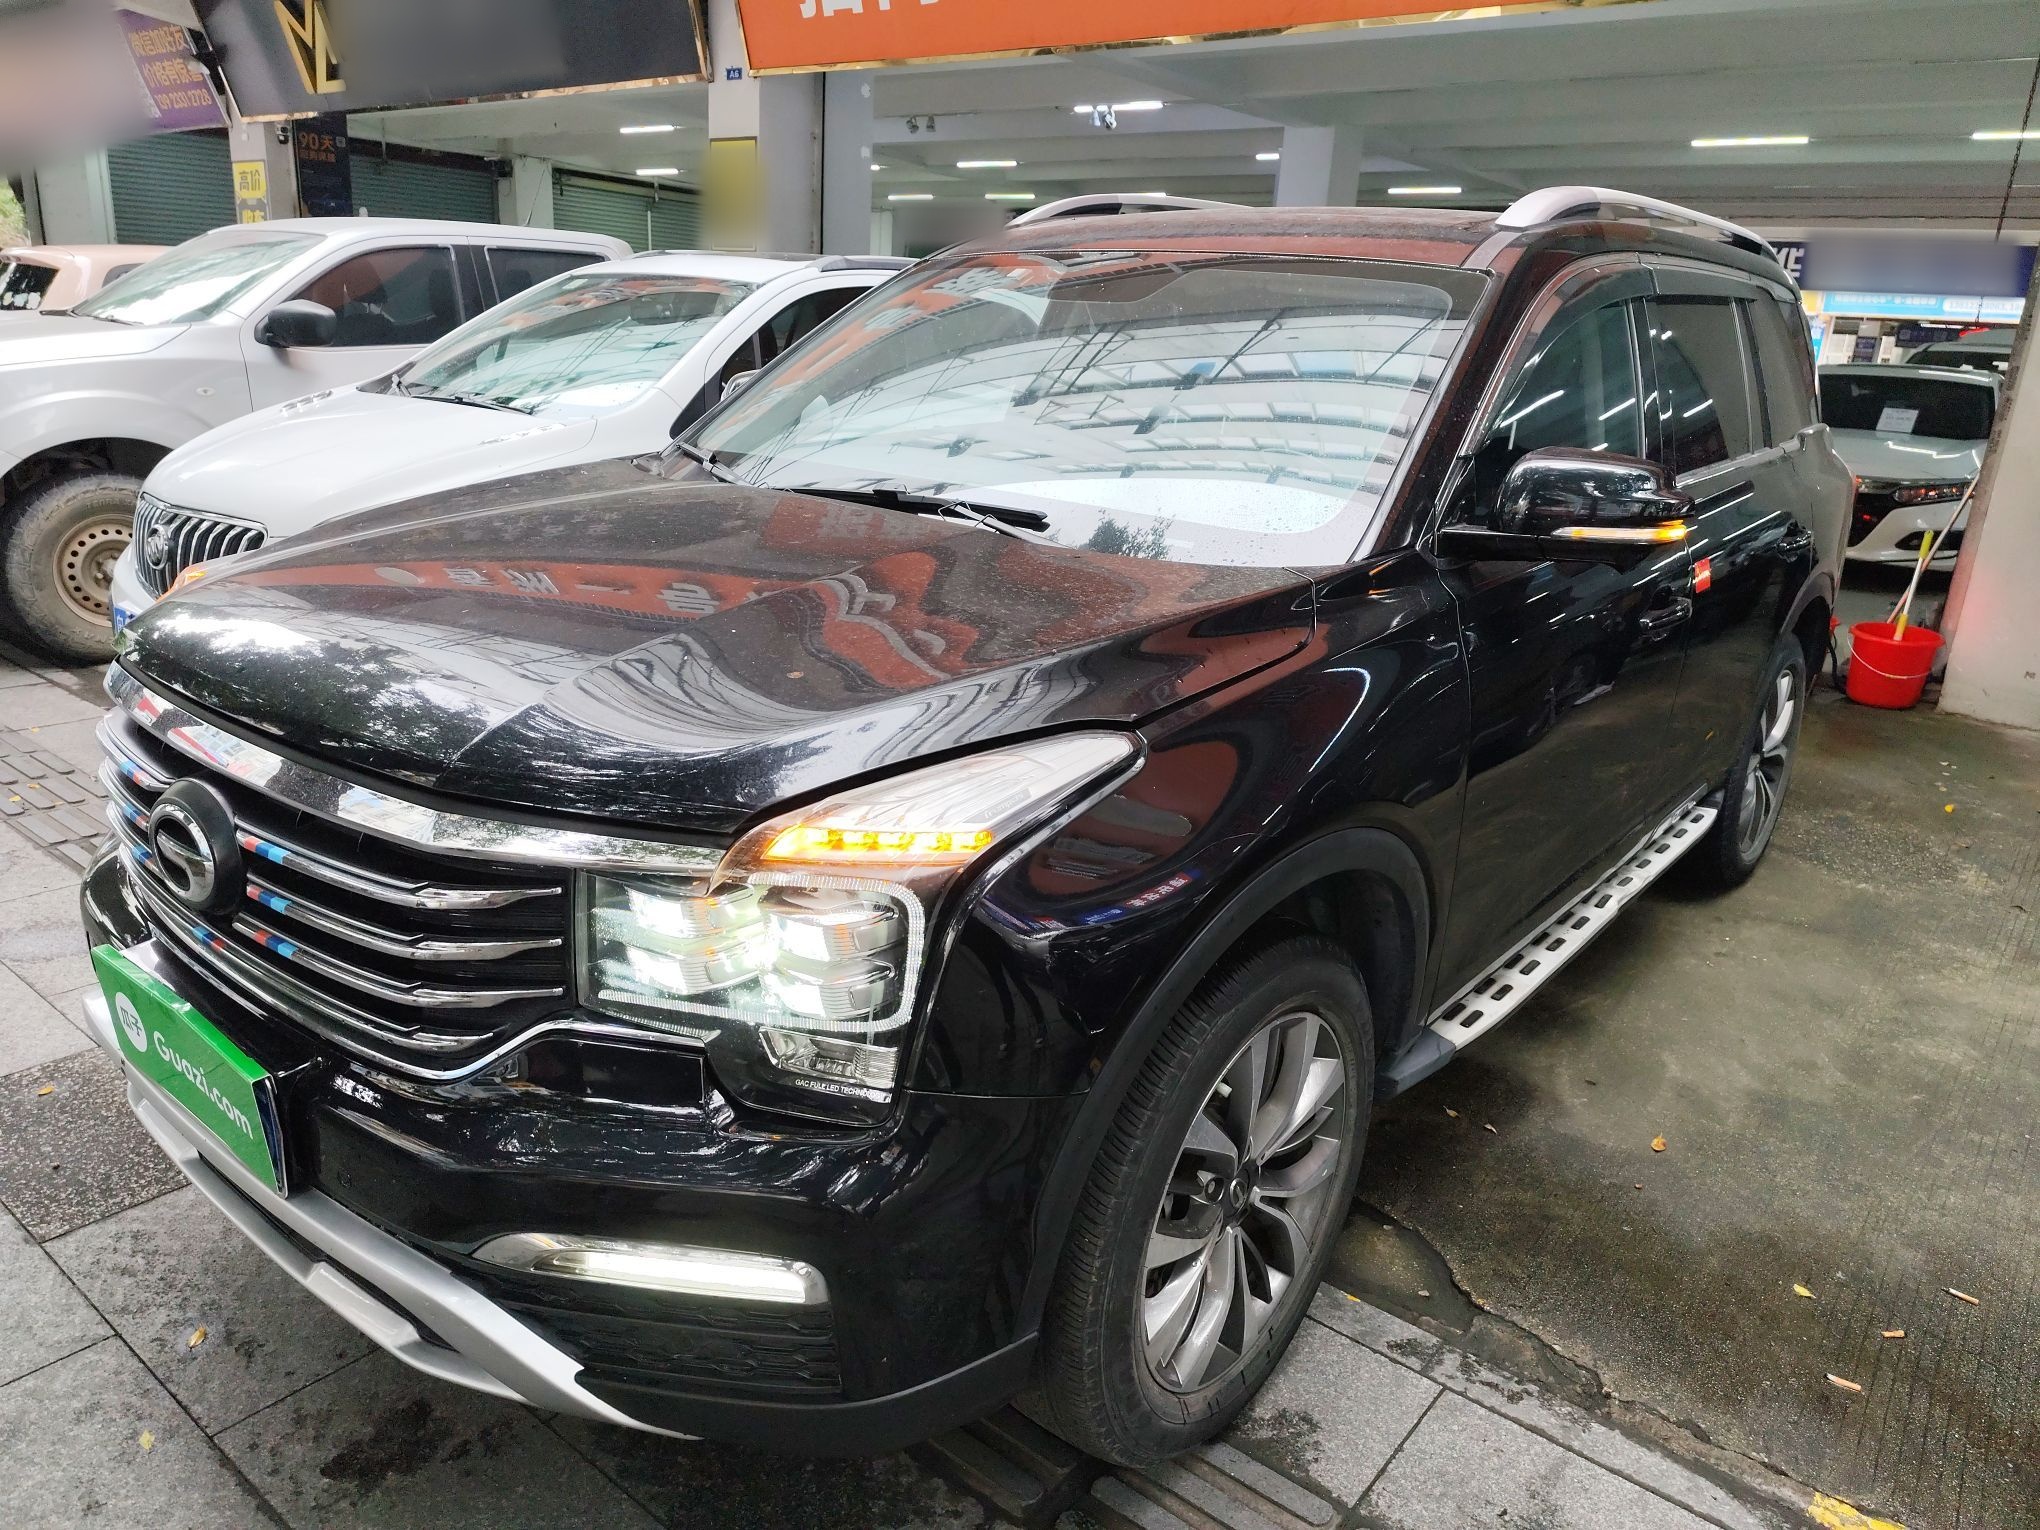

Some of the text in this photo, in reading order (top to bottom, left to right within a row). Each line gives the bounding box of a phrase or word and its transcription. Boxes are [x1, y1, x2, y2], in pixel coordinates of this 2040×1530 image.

[730, 70, 740, 78] A6
[298, 132, 335, 152] 90天
[239, 169, 261, 191] 高价
[153, 1030, 254, 1140] Guazi.com
[795, 1078, 810, 1087] GAC
[826, 1084, 840, 1092] LED
